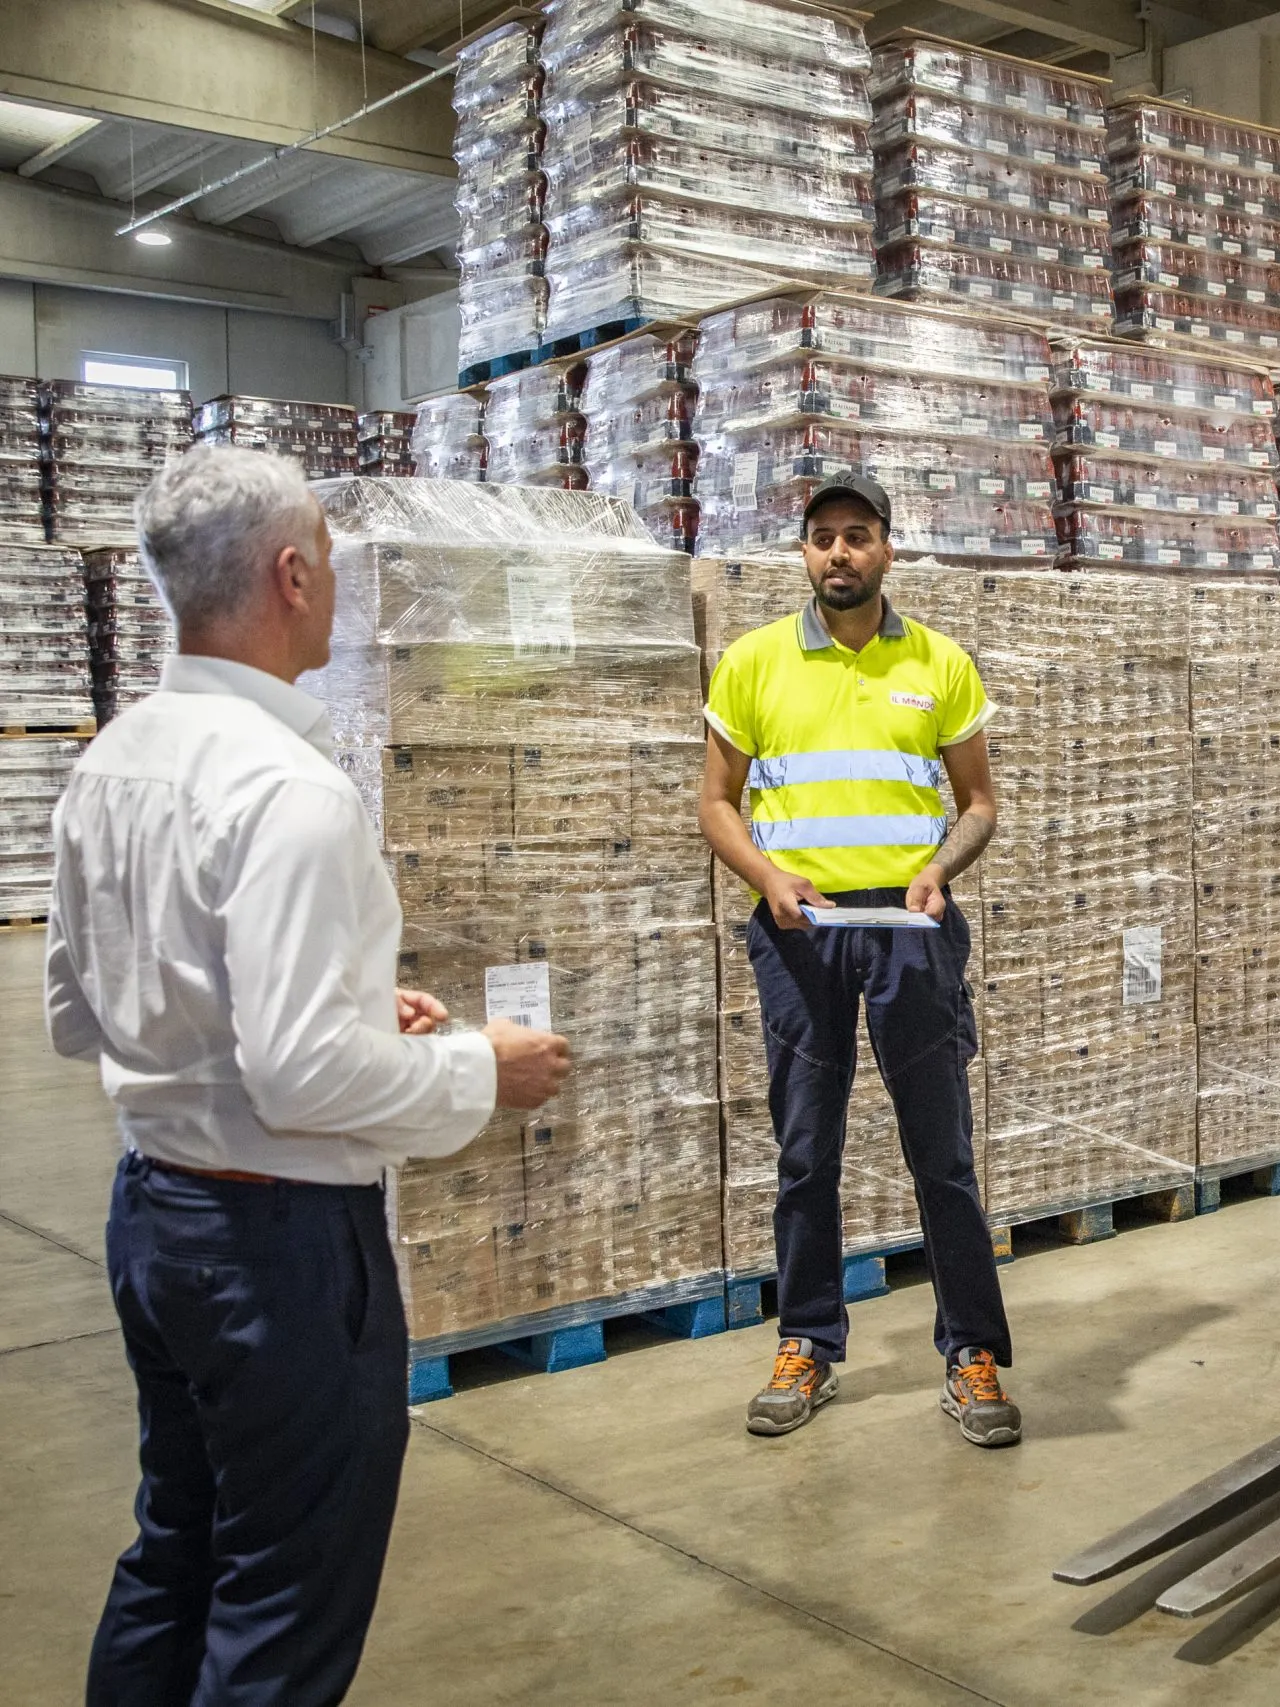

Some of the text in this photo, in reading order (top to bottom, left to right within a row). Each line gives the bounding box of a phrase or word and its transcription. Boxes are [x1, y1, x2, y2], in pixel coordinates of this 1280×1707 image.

[832, 402, 858, 413] ITALIAMO
[891, 695, 936, 711] IL MONDO
